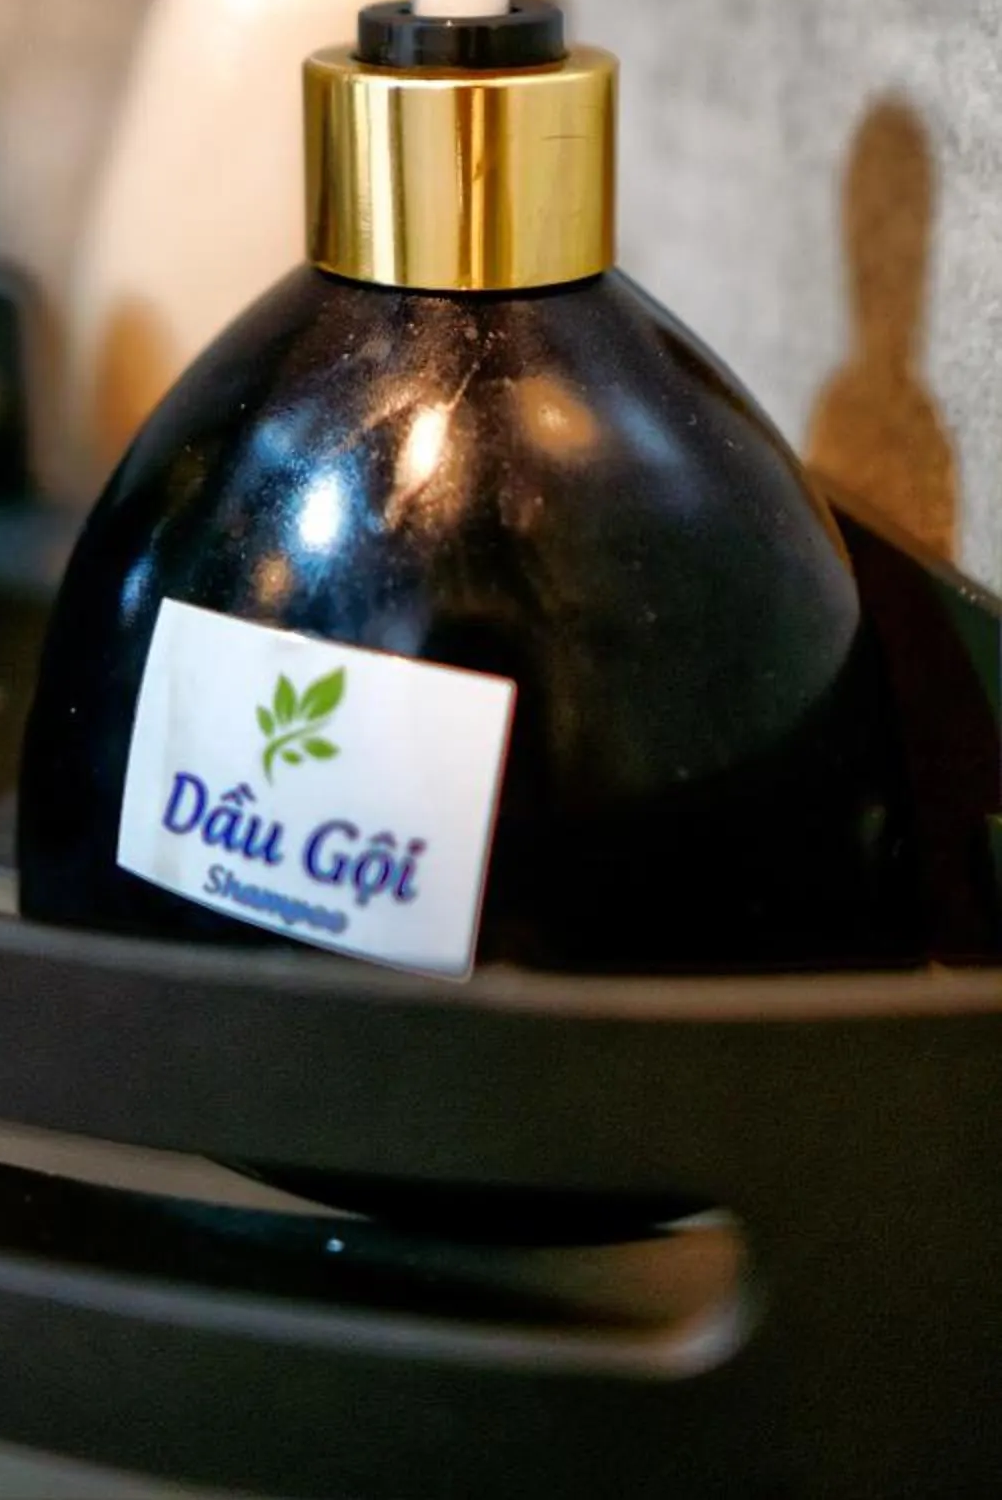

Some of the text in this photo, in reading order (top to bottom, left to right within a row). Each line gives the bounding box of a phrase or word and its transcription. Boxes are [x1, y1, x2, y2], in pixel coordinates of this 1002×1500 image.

[163, 771, 426, 906] Dầu Gội
[203, 865, 348, 934] Shampoo
